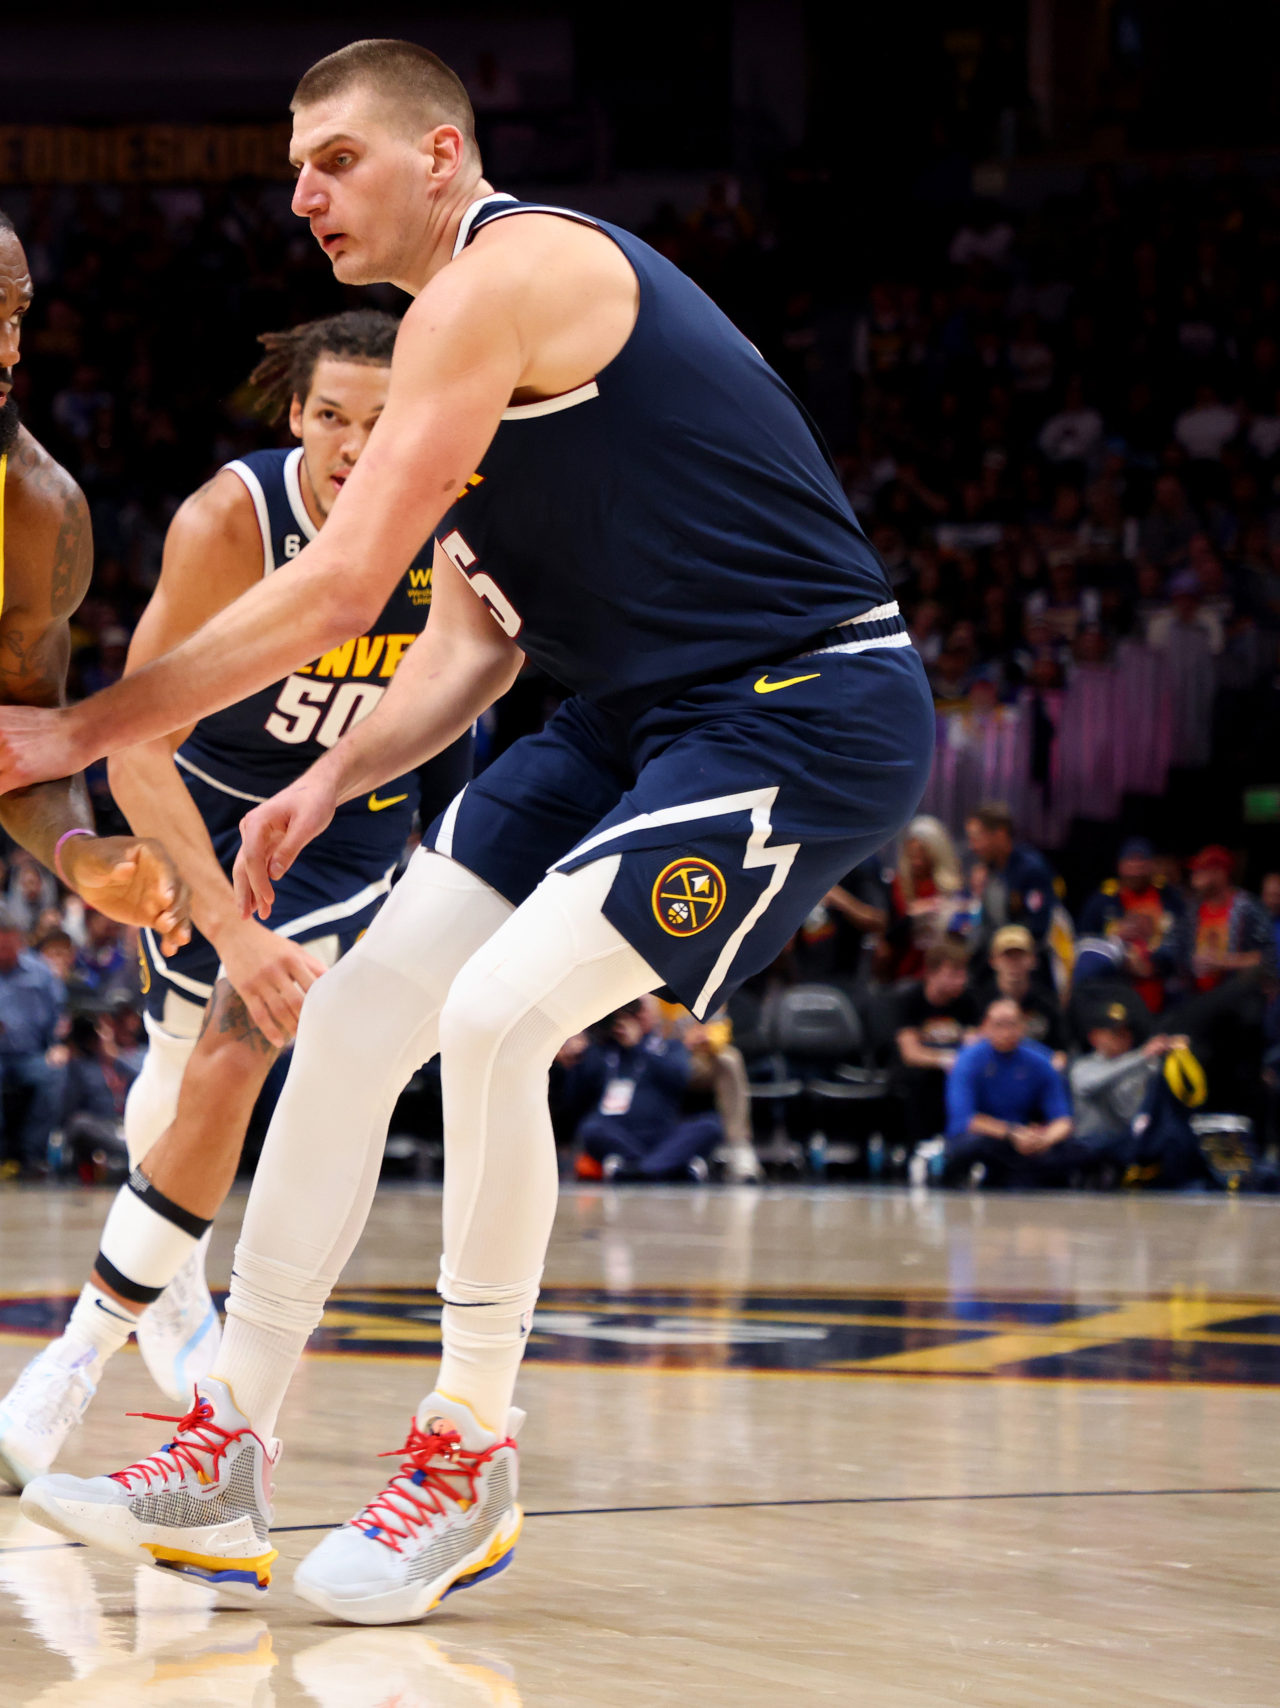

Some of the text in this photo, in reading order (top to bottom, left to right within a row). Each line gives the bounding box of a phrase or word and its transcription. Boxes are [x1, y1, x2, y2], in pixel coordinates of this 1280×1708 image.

[283, 532, 301, 559] 6
[409, 567, 432, 588] W
[263, 673, 387, 750] 50
